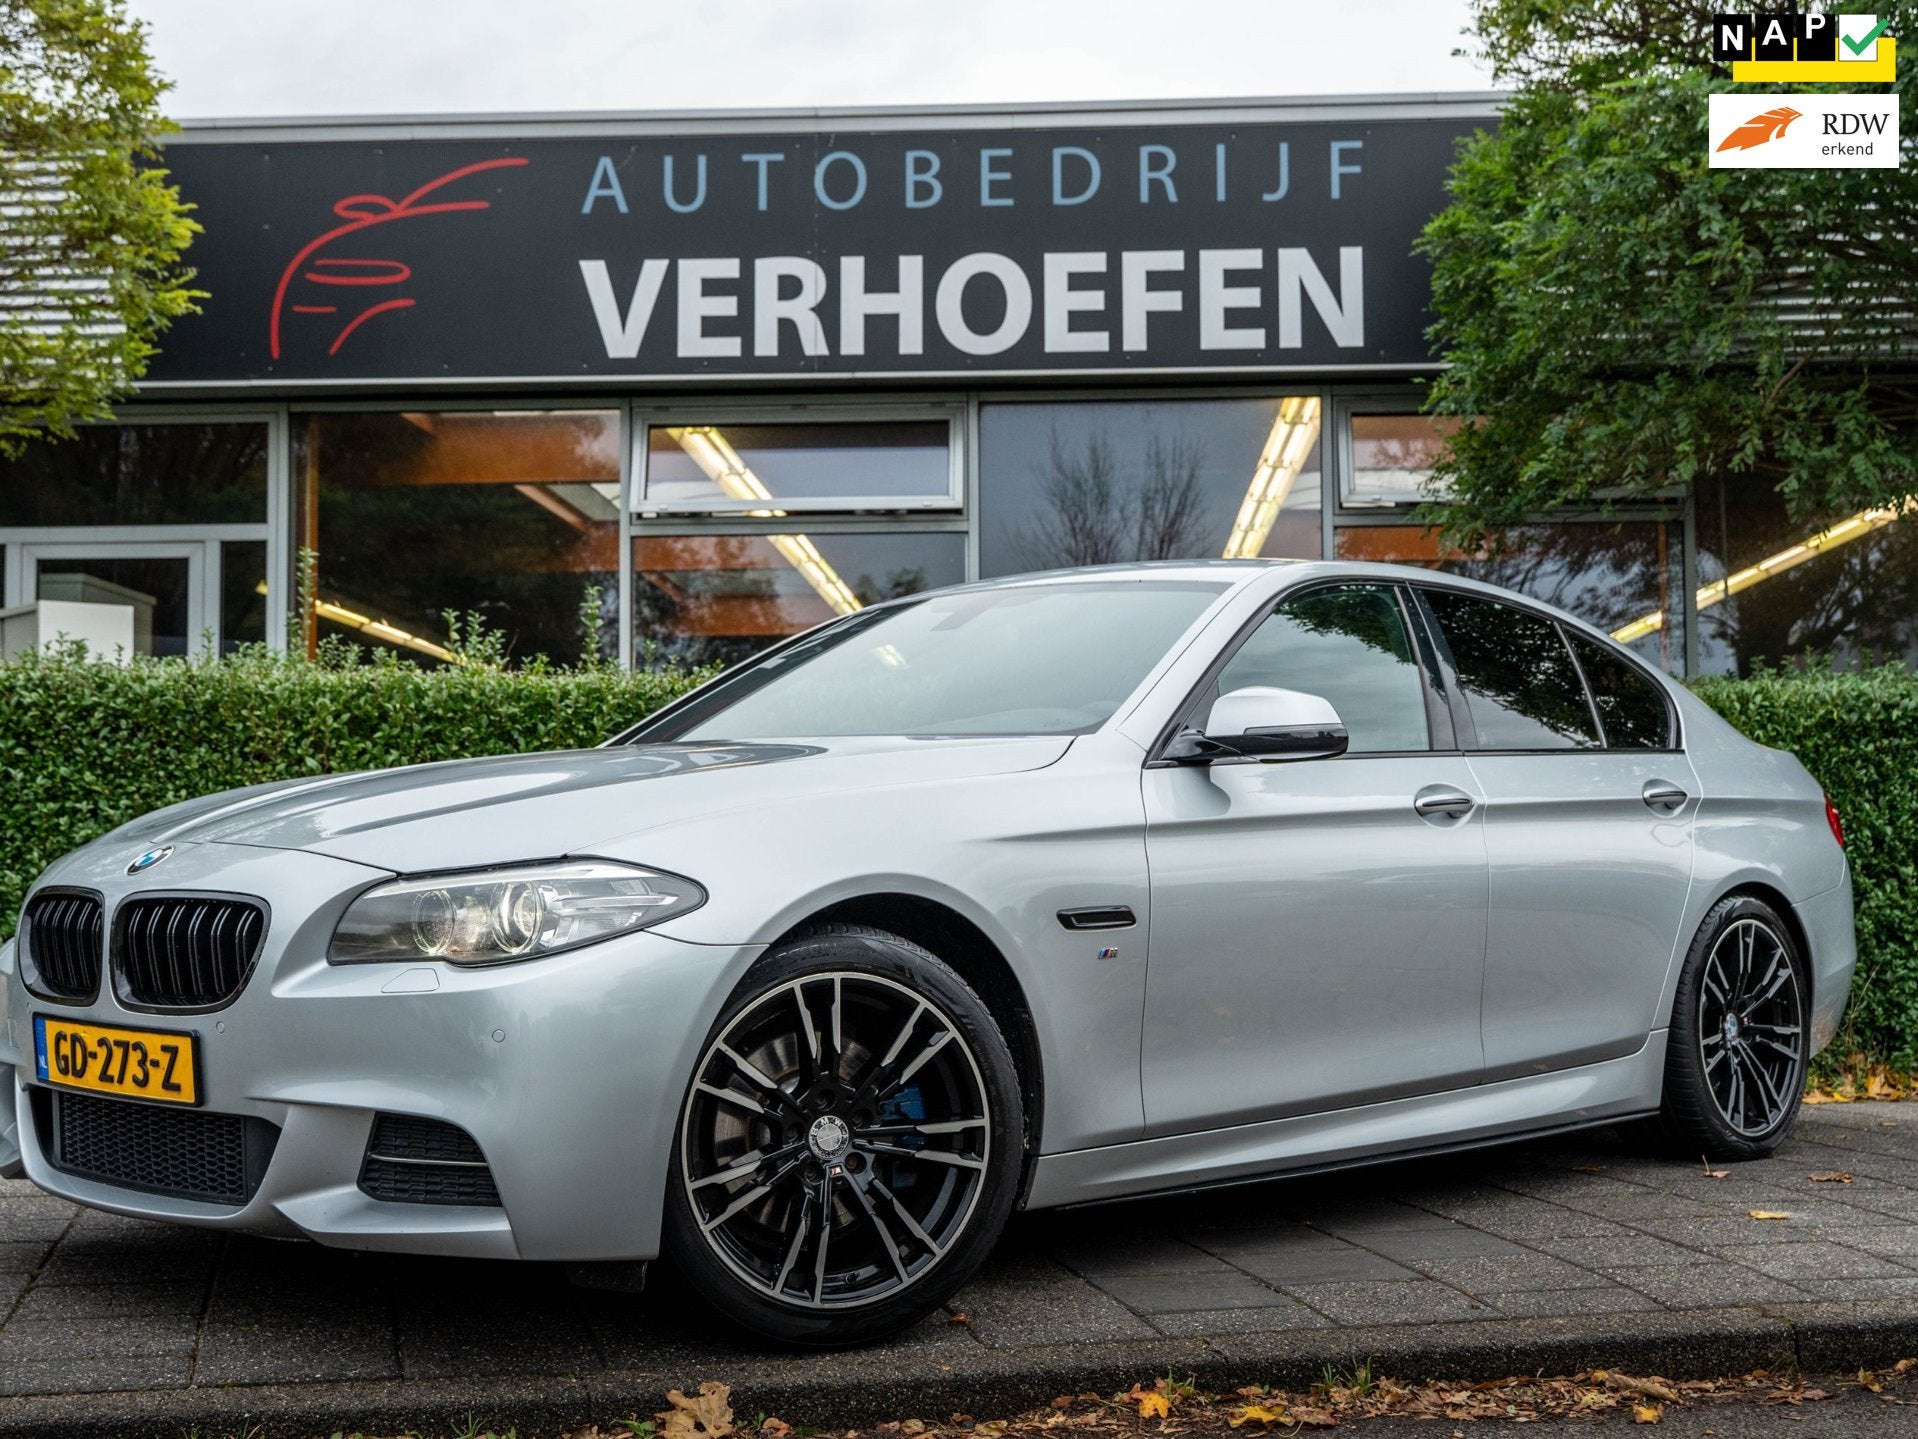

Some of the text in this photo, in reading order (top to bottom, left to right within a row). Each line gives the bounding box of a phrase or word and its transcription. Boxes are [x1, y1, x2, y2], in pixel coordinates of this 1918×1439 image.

[581, 140, 1364, 214] AUTOBEDRIJF
[579, 245, 1364, 359] VERHOEFEN
[54, 1030, 181, 1092] GD-273-Z
